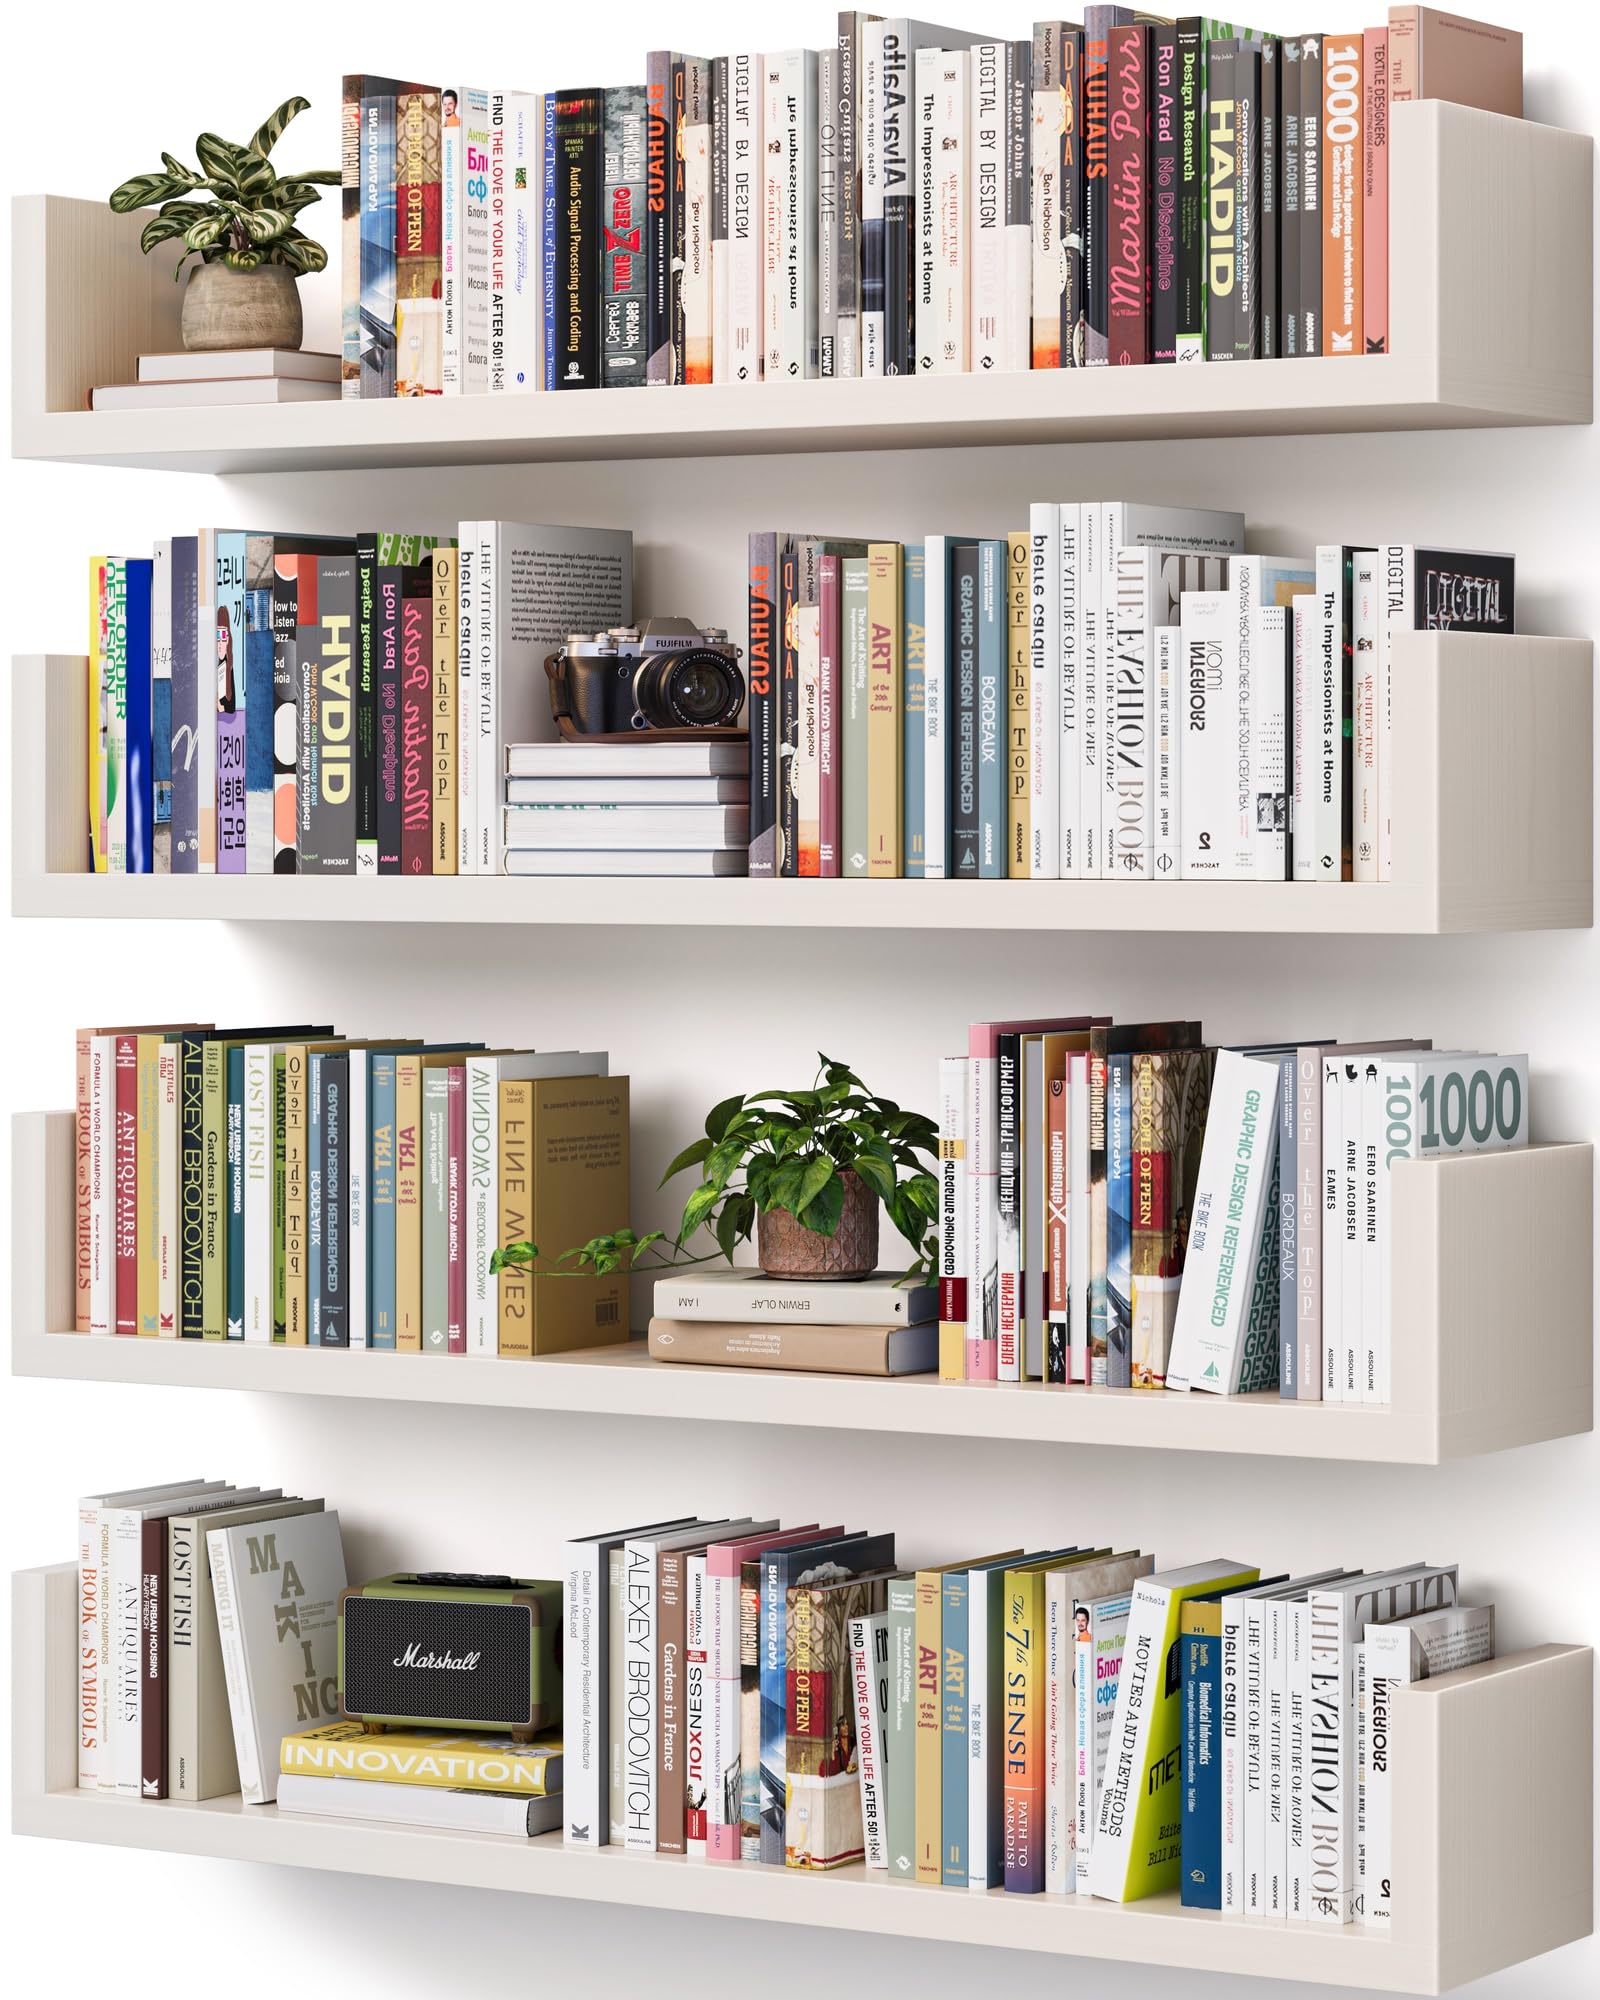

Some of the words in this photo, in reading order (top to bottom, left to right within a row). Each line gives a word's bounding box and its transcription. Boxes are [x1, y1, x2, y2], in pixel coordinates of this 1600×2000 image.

[980, 46, 996, 117] DIGITAL
[1111, 32, 1140, 142] Parr
[1158, 46, 1174, 86] Ron
[1183, 52, 1196, 106] Design
[1374, 44, 1385, 85] TEXTILE
[493, 96, 504, 125] FIND
[922, 94, 934, 120] The
[1086, 41, 1107, 179] BAUHAUS
[1158, 94, 1174, 141] Arad
[1326, 46, 1359, 143] 1000
[1374, 88, 1385, 147] DESIGNERS
[493, 130, 504, 155] THE
[980, 130, 996, 149] BY
[1183, 110, 1196, 181] Research
[1242, 99, 1250, 202] Conversations
[1286, 115, 1297, 146] ARNE
[1304, 117, 1317, 147] EERO
[368, 108, 379, 211] КАРДИОЛОГИЯ
[493, 160, 504, 194] LOVE
[568, 167, 582, 197] Audio
[922, 127, 934, 236] Impressionists
[1158, 158, 1174, 186] No
[1286, 150, 1297, 210] JACOBSEN
[1304, 151, 1317, 210] SAARINEN
[493, 199, 504, 215] OF
[612, 187, 631, 229] ZERO
[980, 163, 996, 228] DESIGN
[1043, 174, 1053, 195] Ben
[1210, 100, 1234, 296] HADID
[493, 221, 504, 257] YOUR
[568, 200, 582, 232] Signal
[1043, 198, 1053, 250] Nicholson
[1111, 153, 1140, 310] Martin
[1242, 206, 1250, 236] with
[568, 236, 582, 290] Processing
[922, 242, 934, 256] at
[1158, 192, 1174, 290] Discipline
[493, 263, 504, 289] LIFE
[614, 255, 632, 292] TIME
[922, 262, 934, 304] Home
[1242, 240, 1250, 312] Architects
[493, 294, 504, 337] AFTER
[568, 293, 582, 312] and
[605, 301, 620, 343] Сергей
[621, 301, 640, 349] Чекмаев
[493, 341, 504, 359] 50!
[568, 316, 582, 351] Coding
[116, 563, 126, 618] THE
[436, 560, 449, 634] Over
[960, 575, 973, 645] GRAPHIC
[1425, 570, 1507, 624] DIGITAL
[656, 640, 692, 648] FUJIFILM
[872, 623, 891, 674] ART
[116, 623, 126, 720] ORDER
[436, 658, 449, 712] the
[928, 678, 938, 693] THE
[960, 649, 973, 707] DESIGN
[928, 697, 938, 713] BIKE
[928, 718, 938, 737] BOOK
[982, 676, 995, 763] BORDEAUX
[1364, 673, 1373, 768] ARCHITECTURE
[436, 733, 449, 795] Top
[960, 712, 973, 814] REFERENCED
[184, 1040, 202, 1141] ALEXEY
[249, 1056, 265, 1118] LOST
[1419, 1066, 1522, 1149] 1000
[207, 1131, 218, 1189] Gardens
[249, 1126, 265, 1178] FISH
[123, 1111, 135, 1257] ANTIQUAIRES
[207, 1193, 218, 1206] in
[944, 1161, 955, 1214] аппараты
[1327, 1169, 1336, 1211] EAMES
[184, 1149, 202, 1318] BRODOVITCH
[207, 1210, 218, 1258] France
[944, 1216, 955, 1275] сварочные
[1282, 1193, 1295, 1282] BORDEAUX
[751, 1299, 777, 1310] OLAF
[778, 1299, 810, 1310] ERWIN
[1001, 1273, 1015, 1330] НЕСТЕРИНА
[1001, 1334, 1015, 1365] ЕЛЕНА
[82, 1543, 90, 1561] THE
[82, 1567, 97, 1624] BOOK
[570, 1571, 579, 1601] Virginia
[582, 1571, 591, 1594] Detail
[1137, 1592, 1166, 1606] Nichols
[570, 1605, 579, 1638] McLeod
[1013, 1595, 1025, 1624] The
[393, 1642, 481, 1671] Marshall
[582, 1607, 591, 1667] Contemporary
[1006, 1630, 1030, 1664] 7th
[582, 1670, 591, 1716] Residential
[1128, 1635, 1151, 1707] MOVIES
[82, 1647, 97, 1749] SYMBOLS
[1199, 1682, 1209, 1722] Biomedical
[582, 1718, 591, 1769] Architecture
[1008, 1672, 1026, 1775] SENSE
[1122, 1713, 1139, 1749] AND
[1199, 1724, 1209, 1764] Informatics
[285, 1743, 541, 1785] INNOVATION
[1100, 1788, 1114, 1825] Volume
[1108, 1752, 1130, 1838] METHODS
[1006, 1796, 1015, 1870] PARADISE
[1018, 1801, 1028, 1843] PATH
[1018, 1847, 1028, 1868] TO
